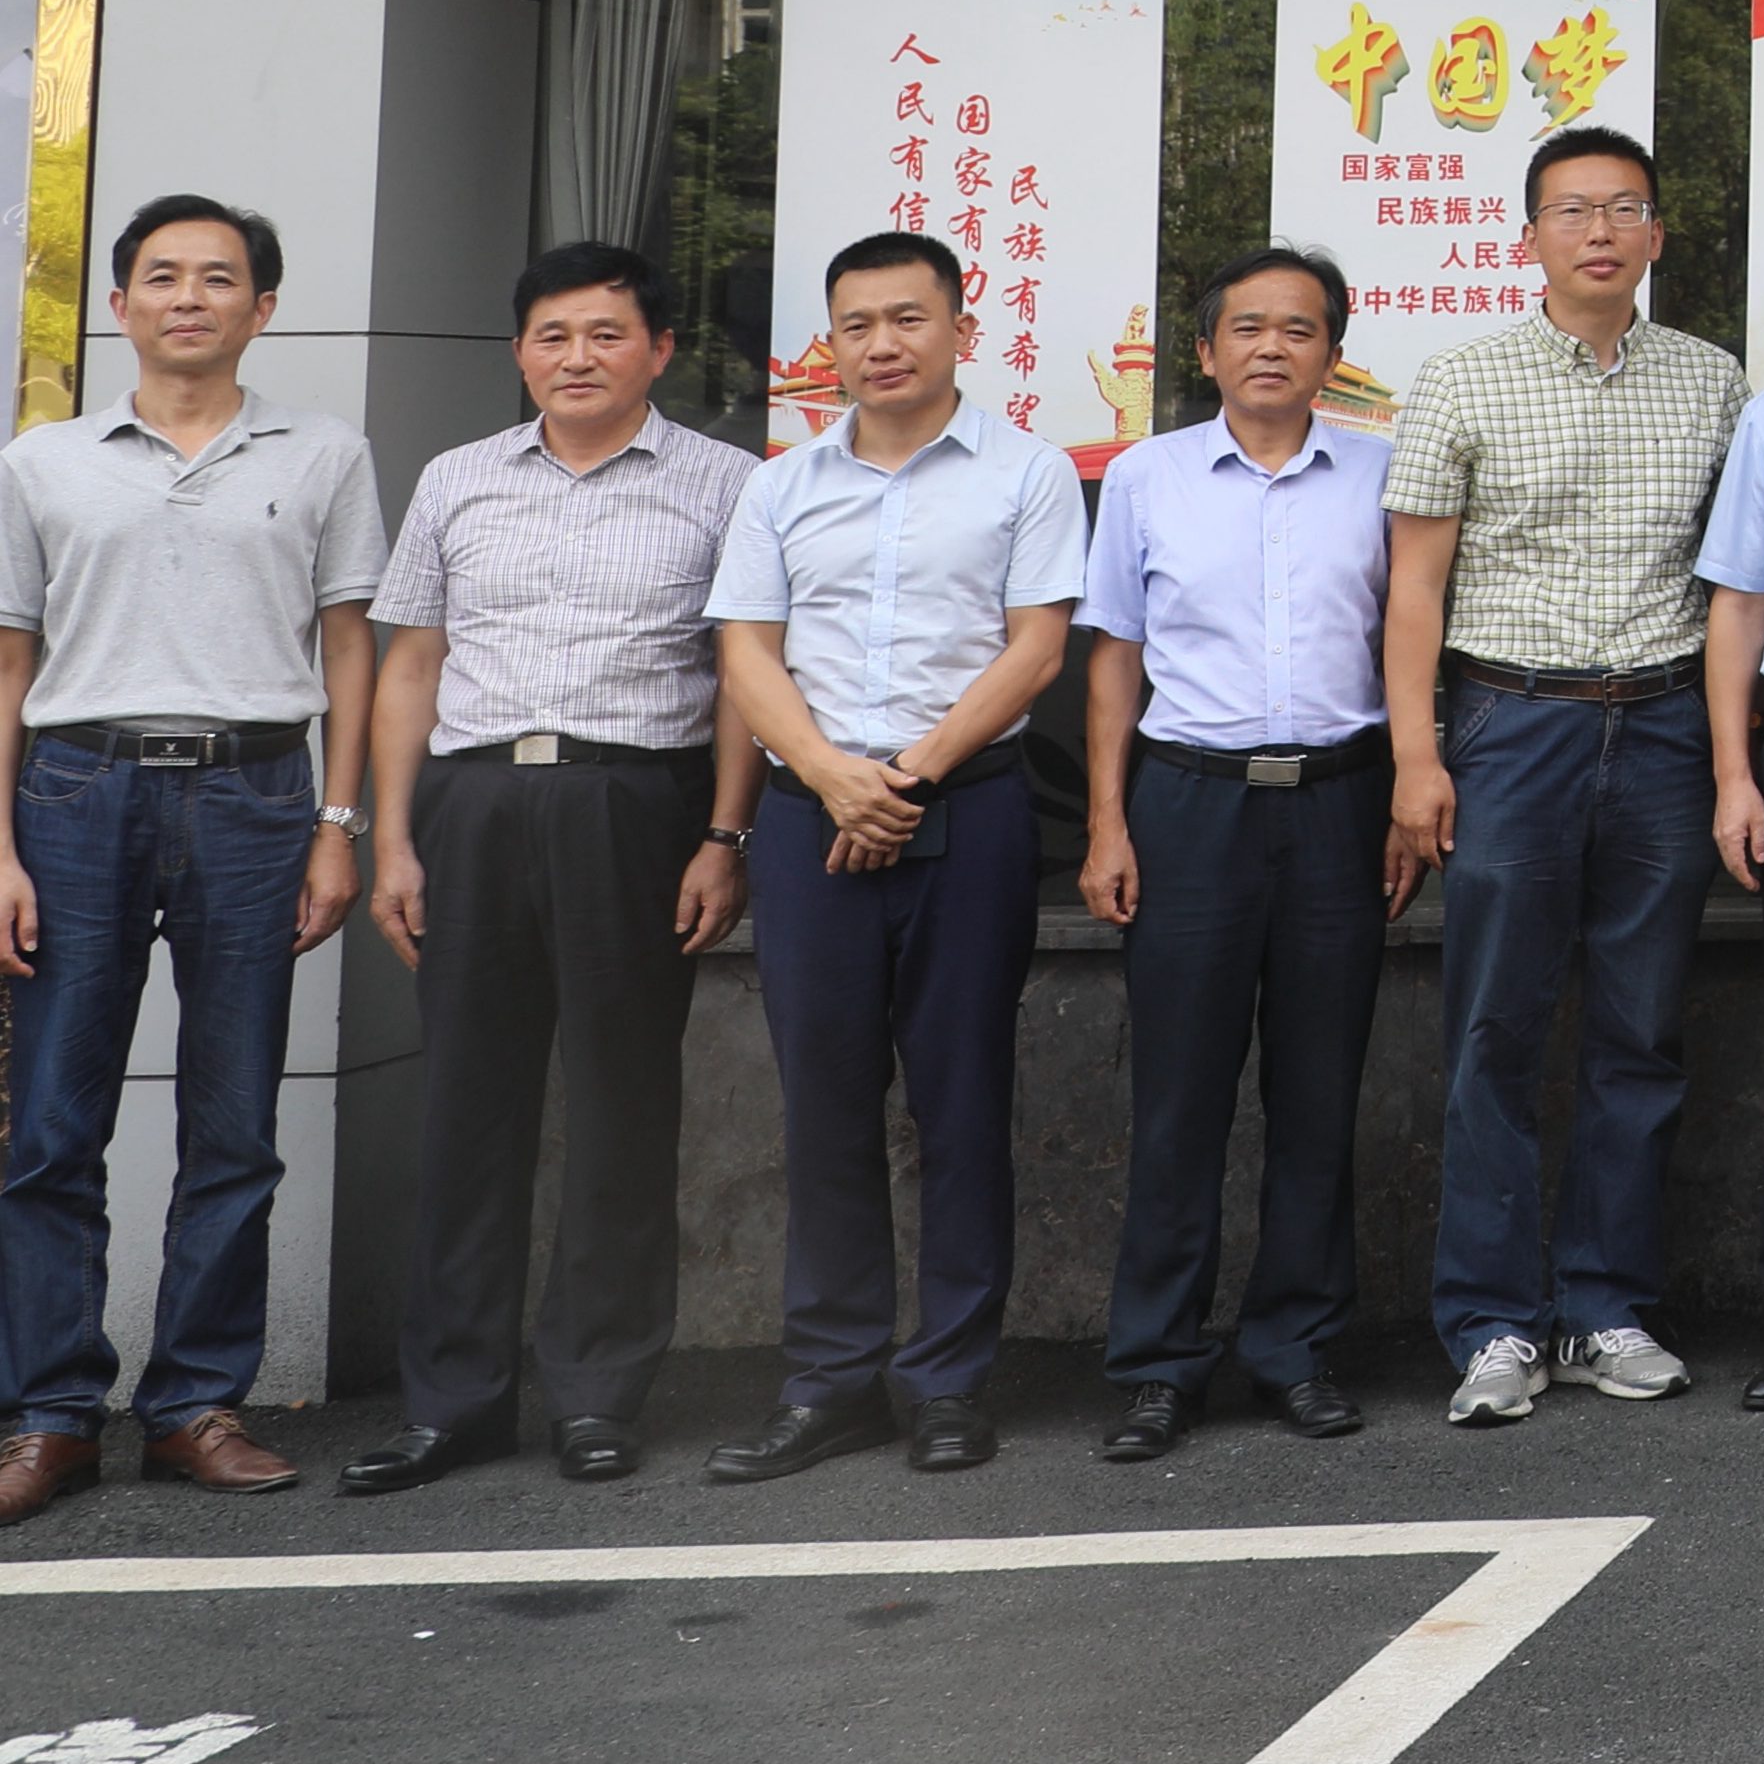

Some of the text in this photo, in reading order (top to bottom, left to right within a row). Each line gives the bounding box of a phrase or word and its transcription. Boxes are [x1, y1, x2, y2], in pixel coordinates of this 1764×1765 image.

[1313, 0, 1629, 145] 中国梦
[1341, 153, 1466, 182] 国家富强
[1376, 195, 1507, 226] 民族振兴
[1001, 165, 1050, 435] 民族有希望
